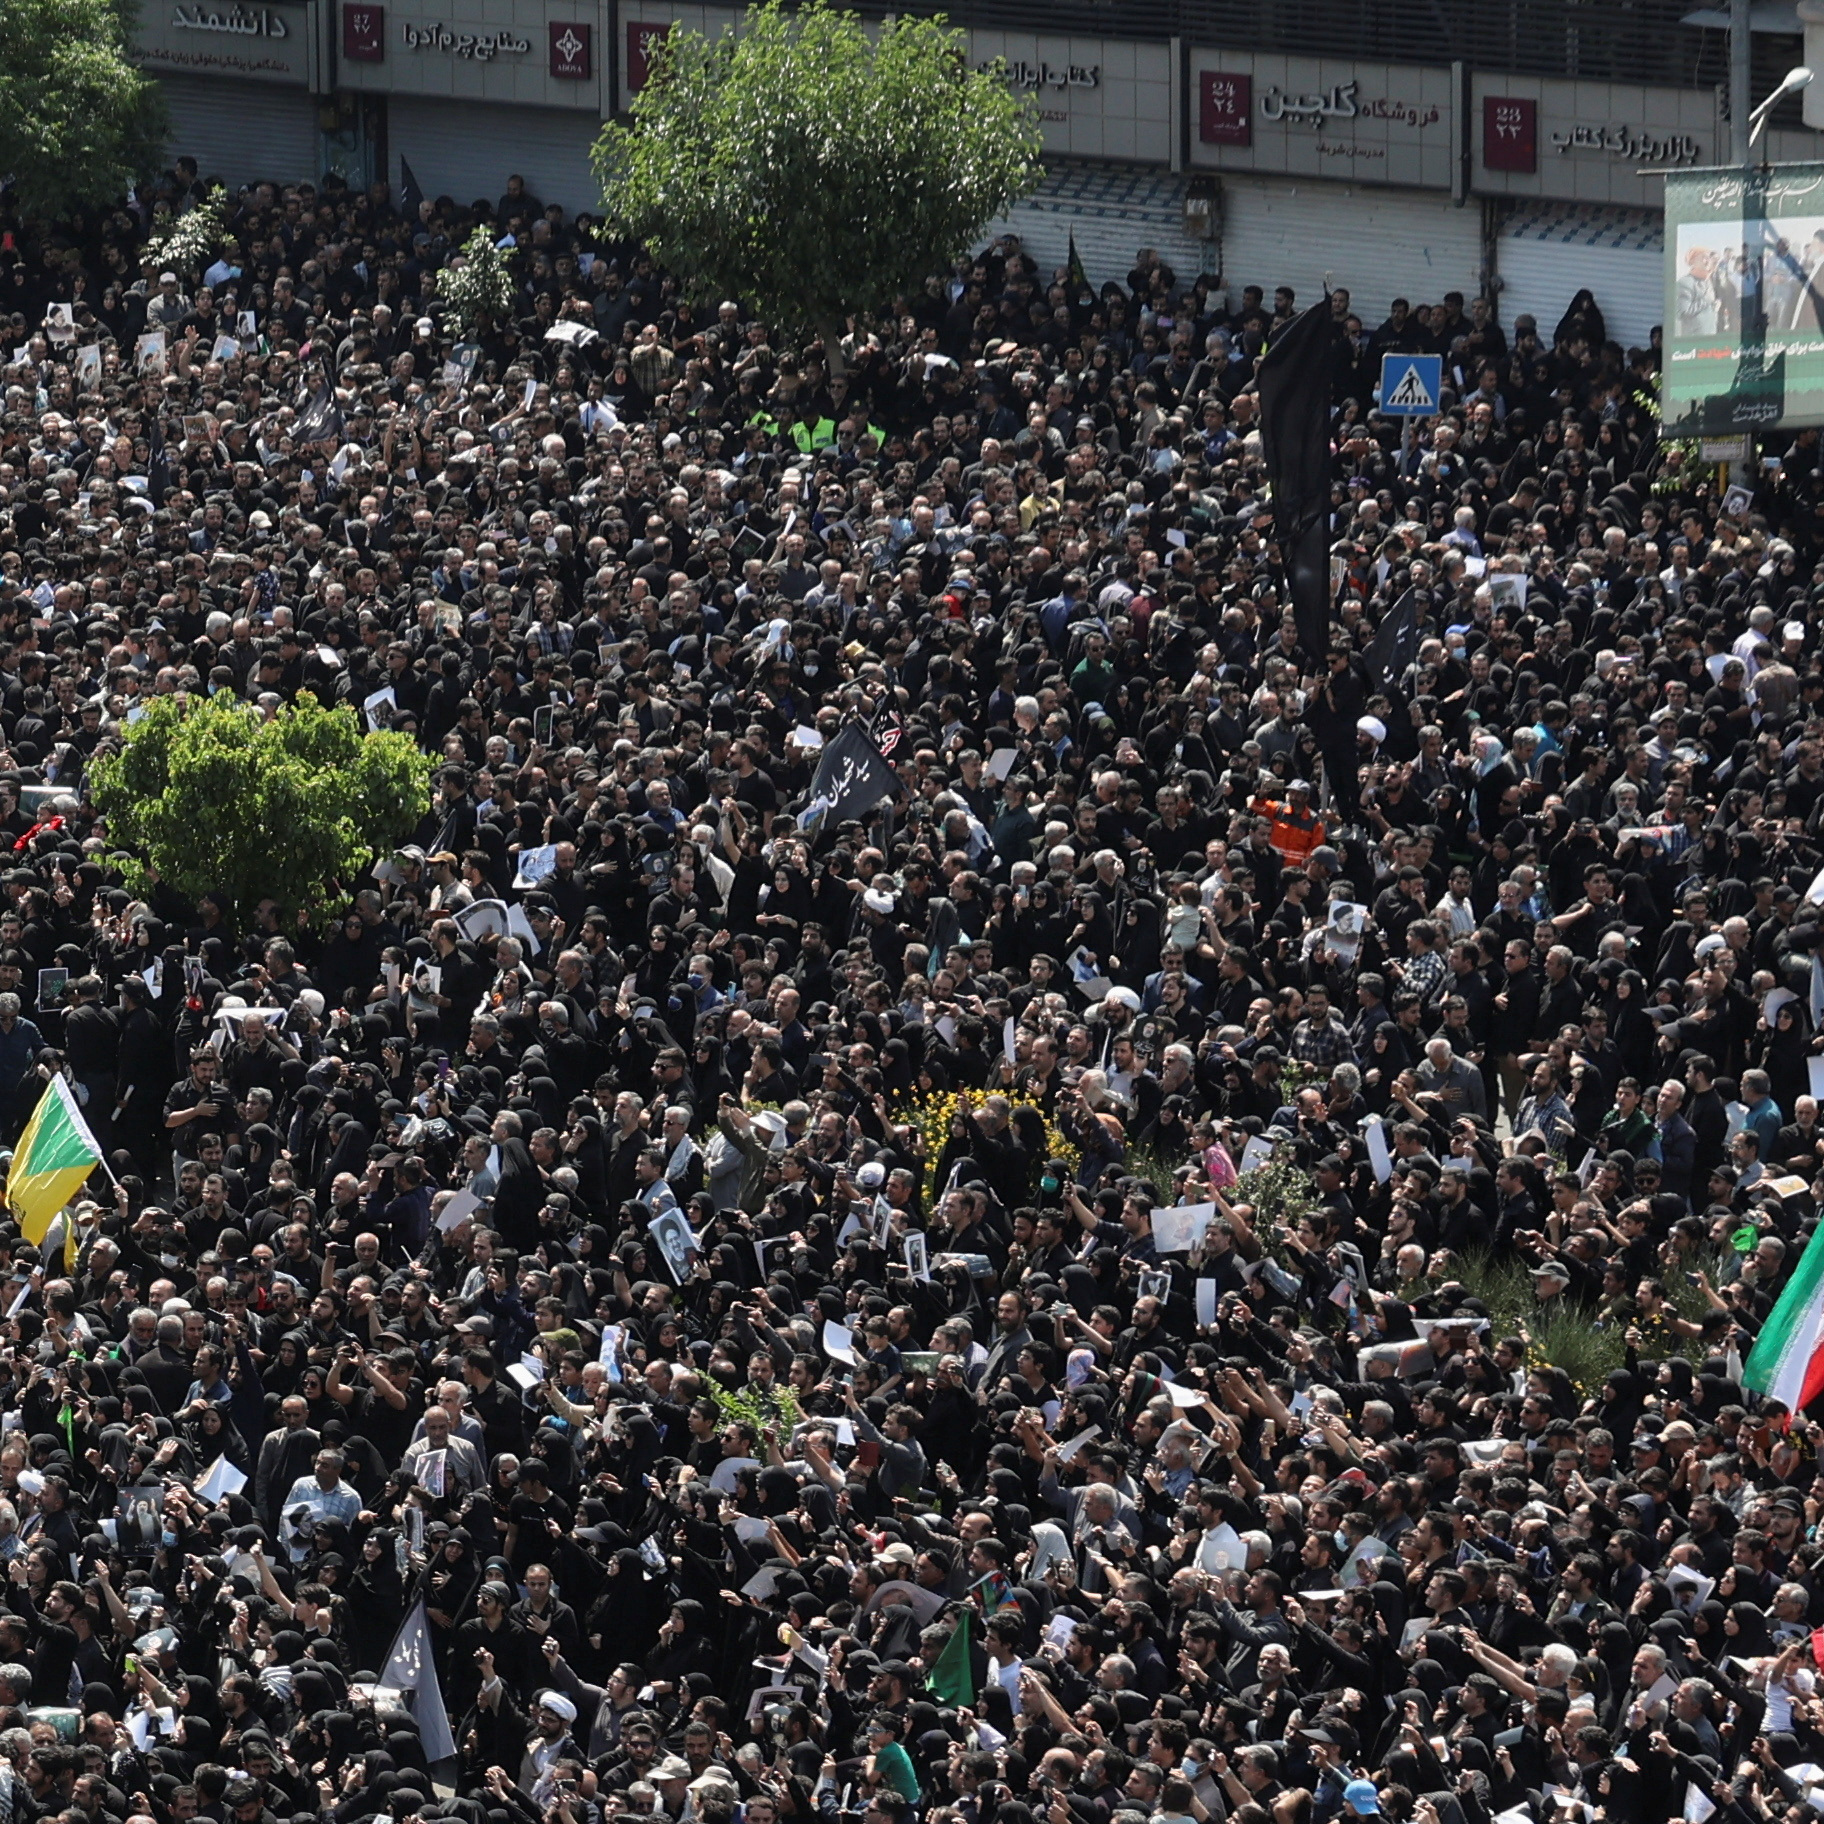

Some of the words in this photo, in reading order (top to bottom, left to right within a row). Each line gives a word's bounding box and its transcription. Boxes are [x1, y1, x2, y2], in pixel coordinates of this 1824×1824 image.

[172, 4, 286, 38] دانشمند
[353, 14, 370, 24] 27
[403, 22, 442, 48] آدوا
[438, 33, 475, 59] چرم
[474, 32, 528, 60] صنایع
[1046, 65, 1099, 91] کتاب
[1212, 81, 1236, 97] 24
[1260, 80, 1358, 129] گلچین
[1361, 98, 1440, 127] فروشگاه
[1496, 106, 1521, 123] 23
[1551, 126, 1605, 153] کتاب
[1604, 124, 1654, 161] بزرگ
[1653, 135, 1698, 164] بازار
